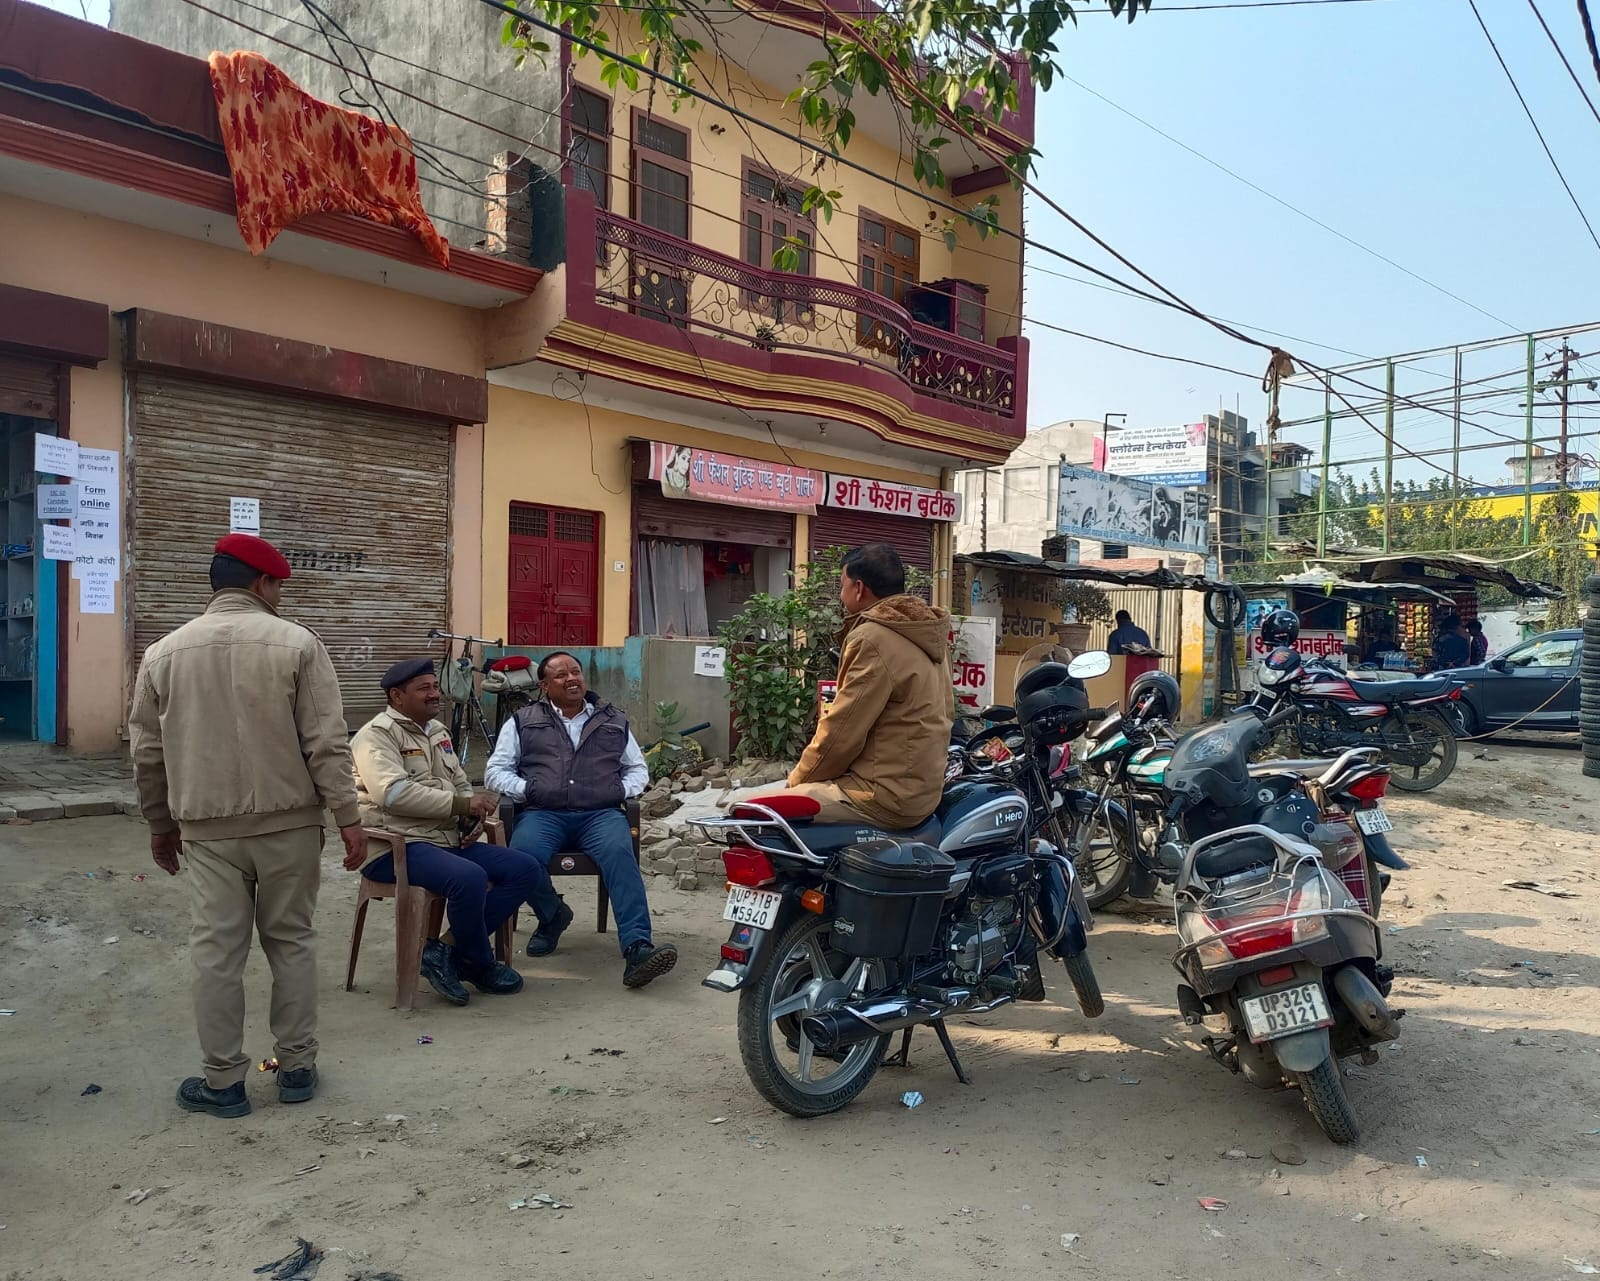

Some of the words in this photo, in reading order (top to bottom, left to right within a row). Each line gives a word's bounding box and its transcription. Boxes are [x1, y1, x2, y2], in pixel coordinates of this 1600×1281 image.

[84, 485, 106, 494] Form
[80, 499, 110, 508] online
[867, 482, 913, 512] फैशन
[917, 490, 956, 518] बुटीक
[85, 531, 104, 539] निवास
[76, 555, 94, 564] फोटो
[98, 556, 116, 565] कॉपी
[1005, 810, 1023, 823] Hero
[1259, 987, 1313, 1013] UP32G
[1265, 1003, 1319, 1031] D3121
